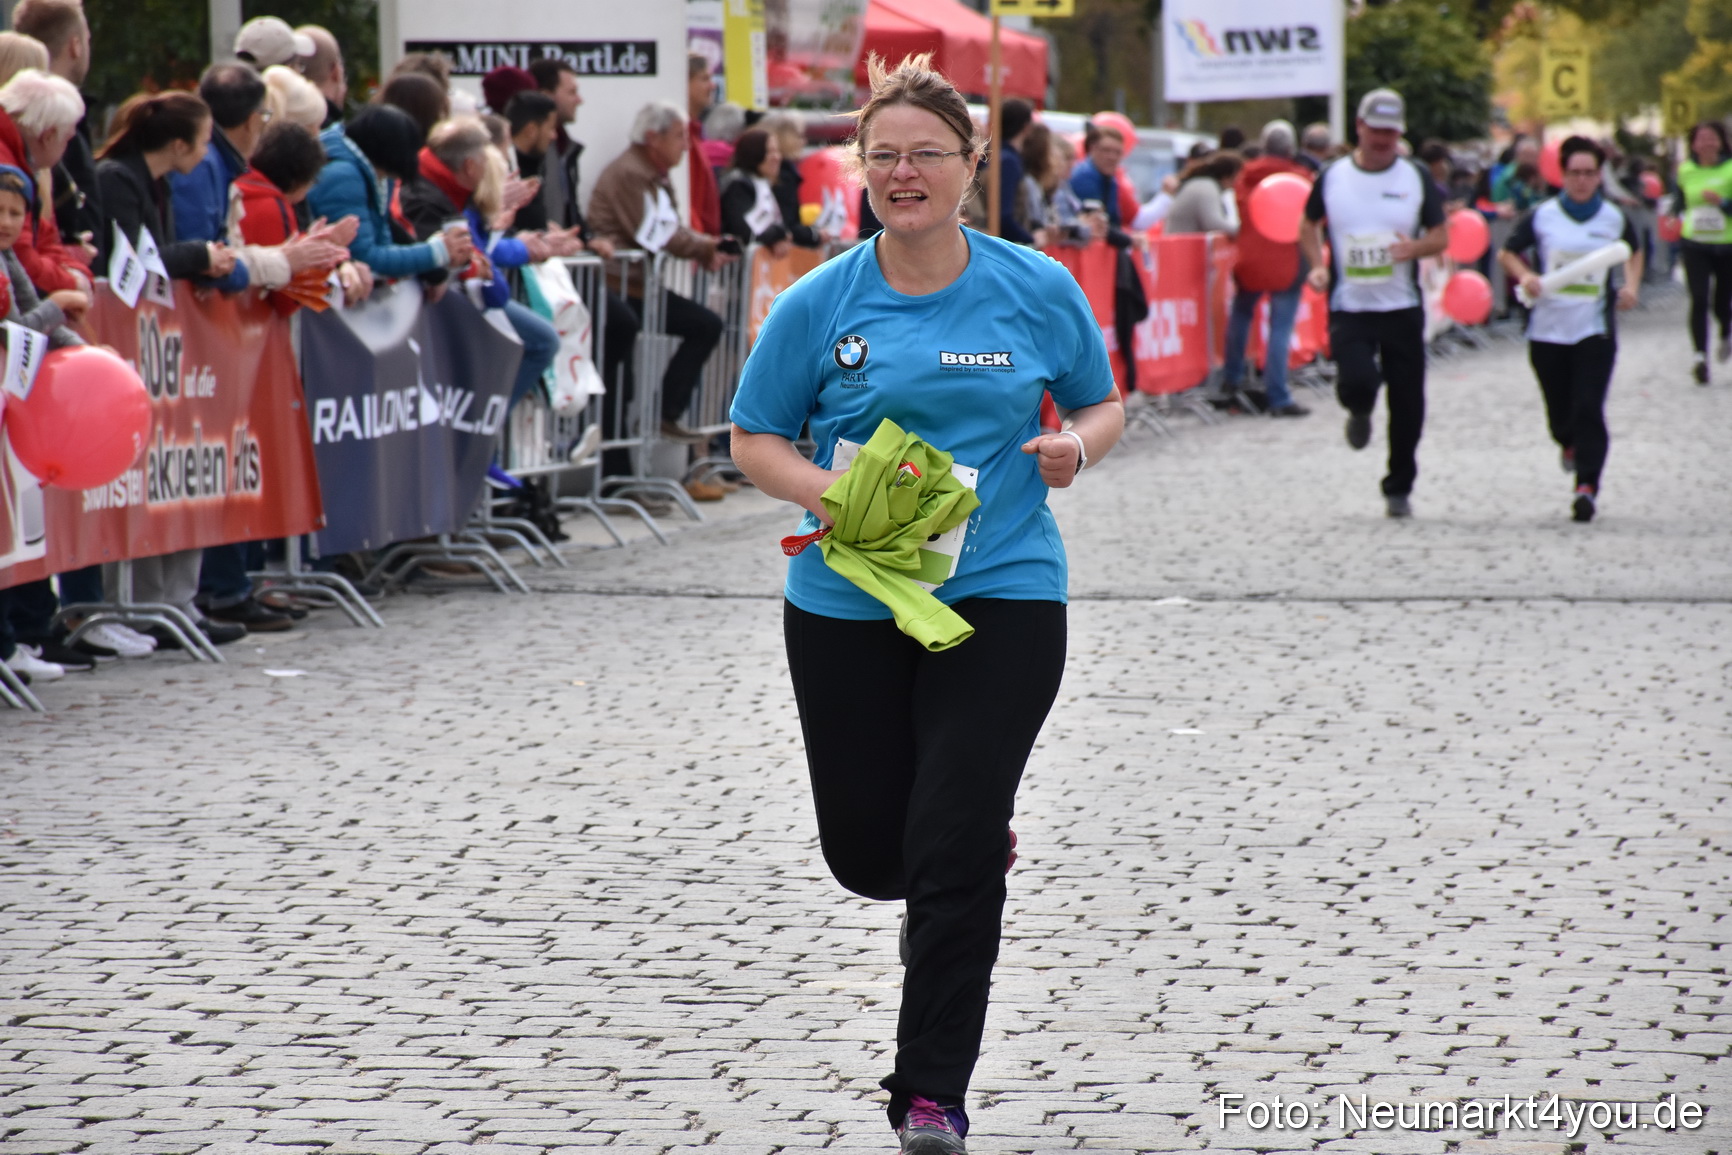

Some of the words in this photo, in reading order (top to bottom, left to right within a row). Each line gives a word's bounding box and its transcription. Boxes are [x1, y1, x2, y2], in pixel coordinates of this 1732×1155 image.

[1552, 64, 1576, 98] C
[836, 336, 867, 349] BMW
[941, 352, 1011, 366] BOCK
[841, 372, 868, 382] PARTL
